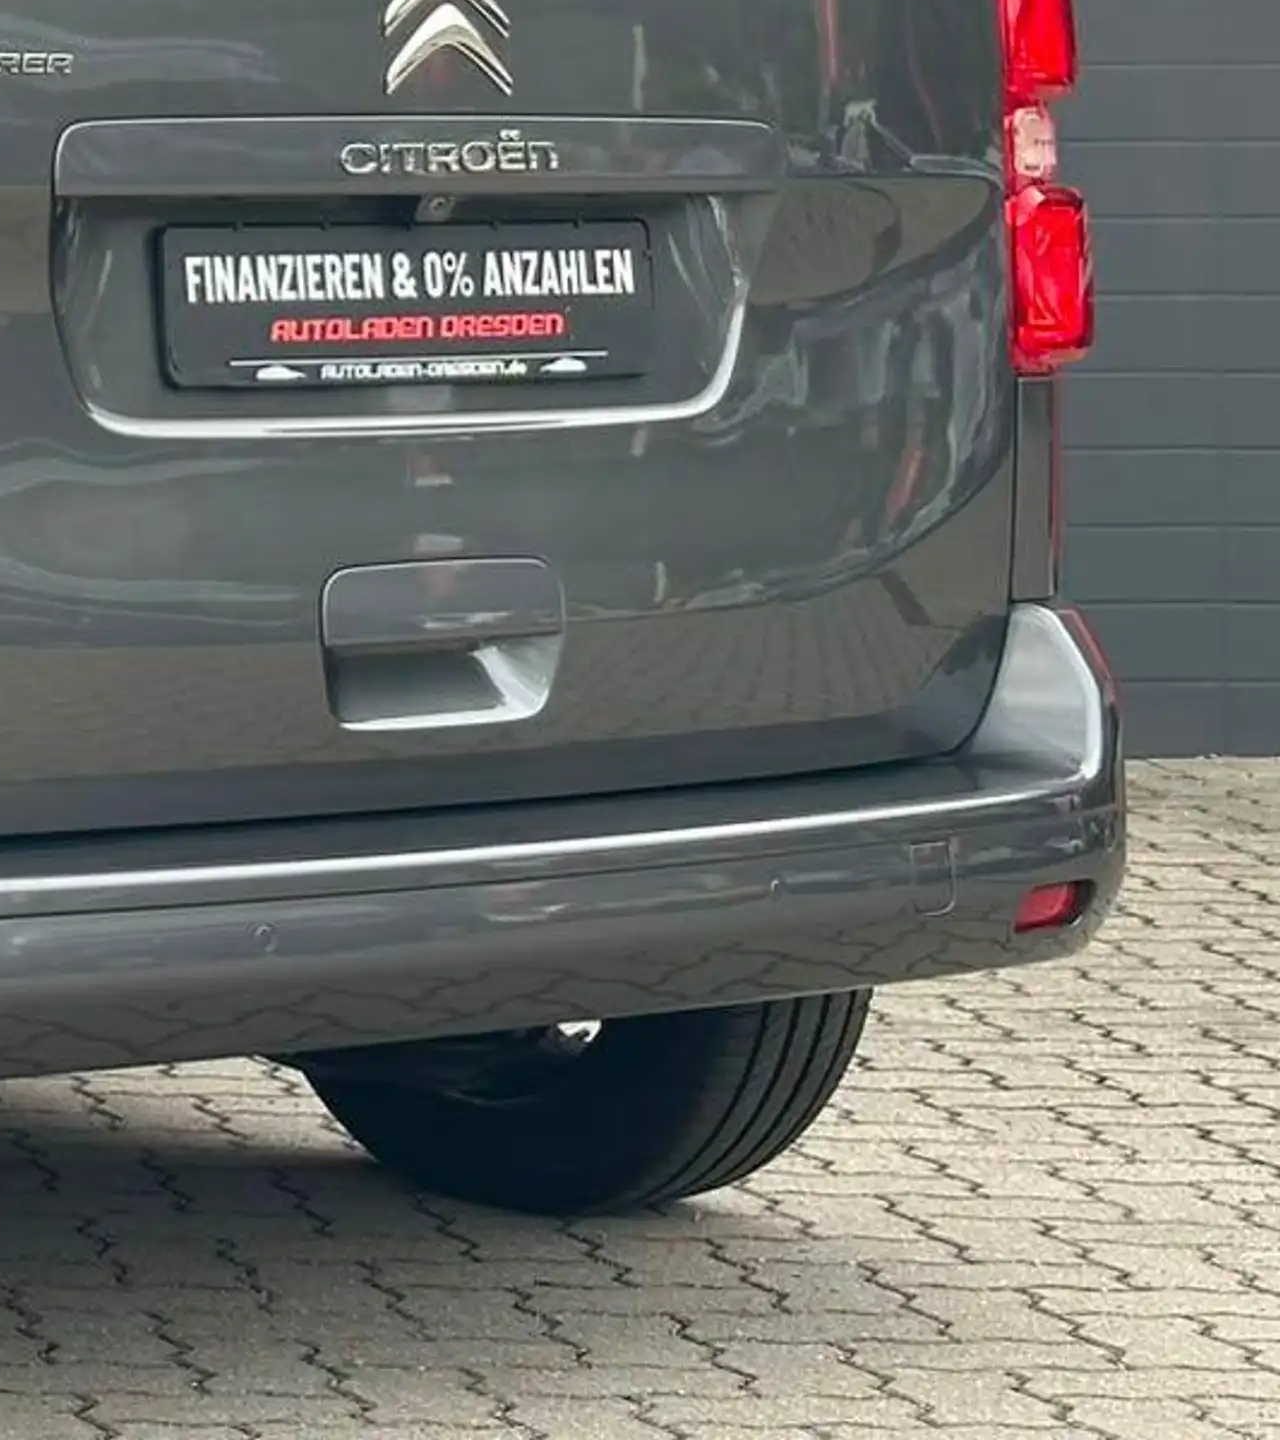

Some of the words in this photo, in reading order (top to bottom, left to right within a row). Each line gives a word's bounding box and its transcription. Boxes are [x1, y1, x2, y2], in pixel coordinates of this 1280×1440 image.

[340, 128, 560, 174] CITROËN
[183, 253, 385, 304] FINANZIEREN
[391, 250, 418, 299] &
[423, 249, 476, 299] 0%
[483, 248, 636, 298] ANZAHLEN
[270, 314, 434, 343] AUTOLADEN
[440, 311, 564, 340] DRESDEN
